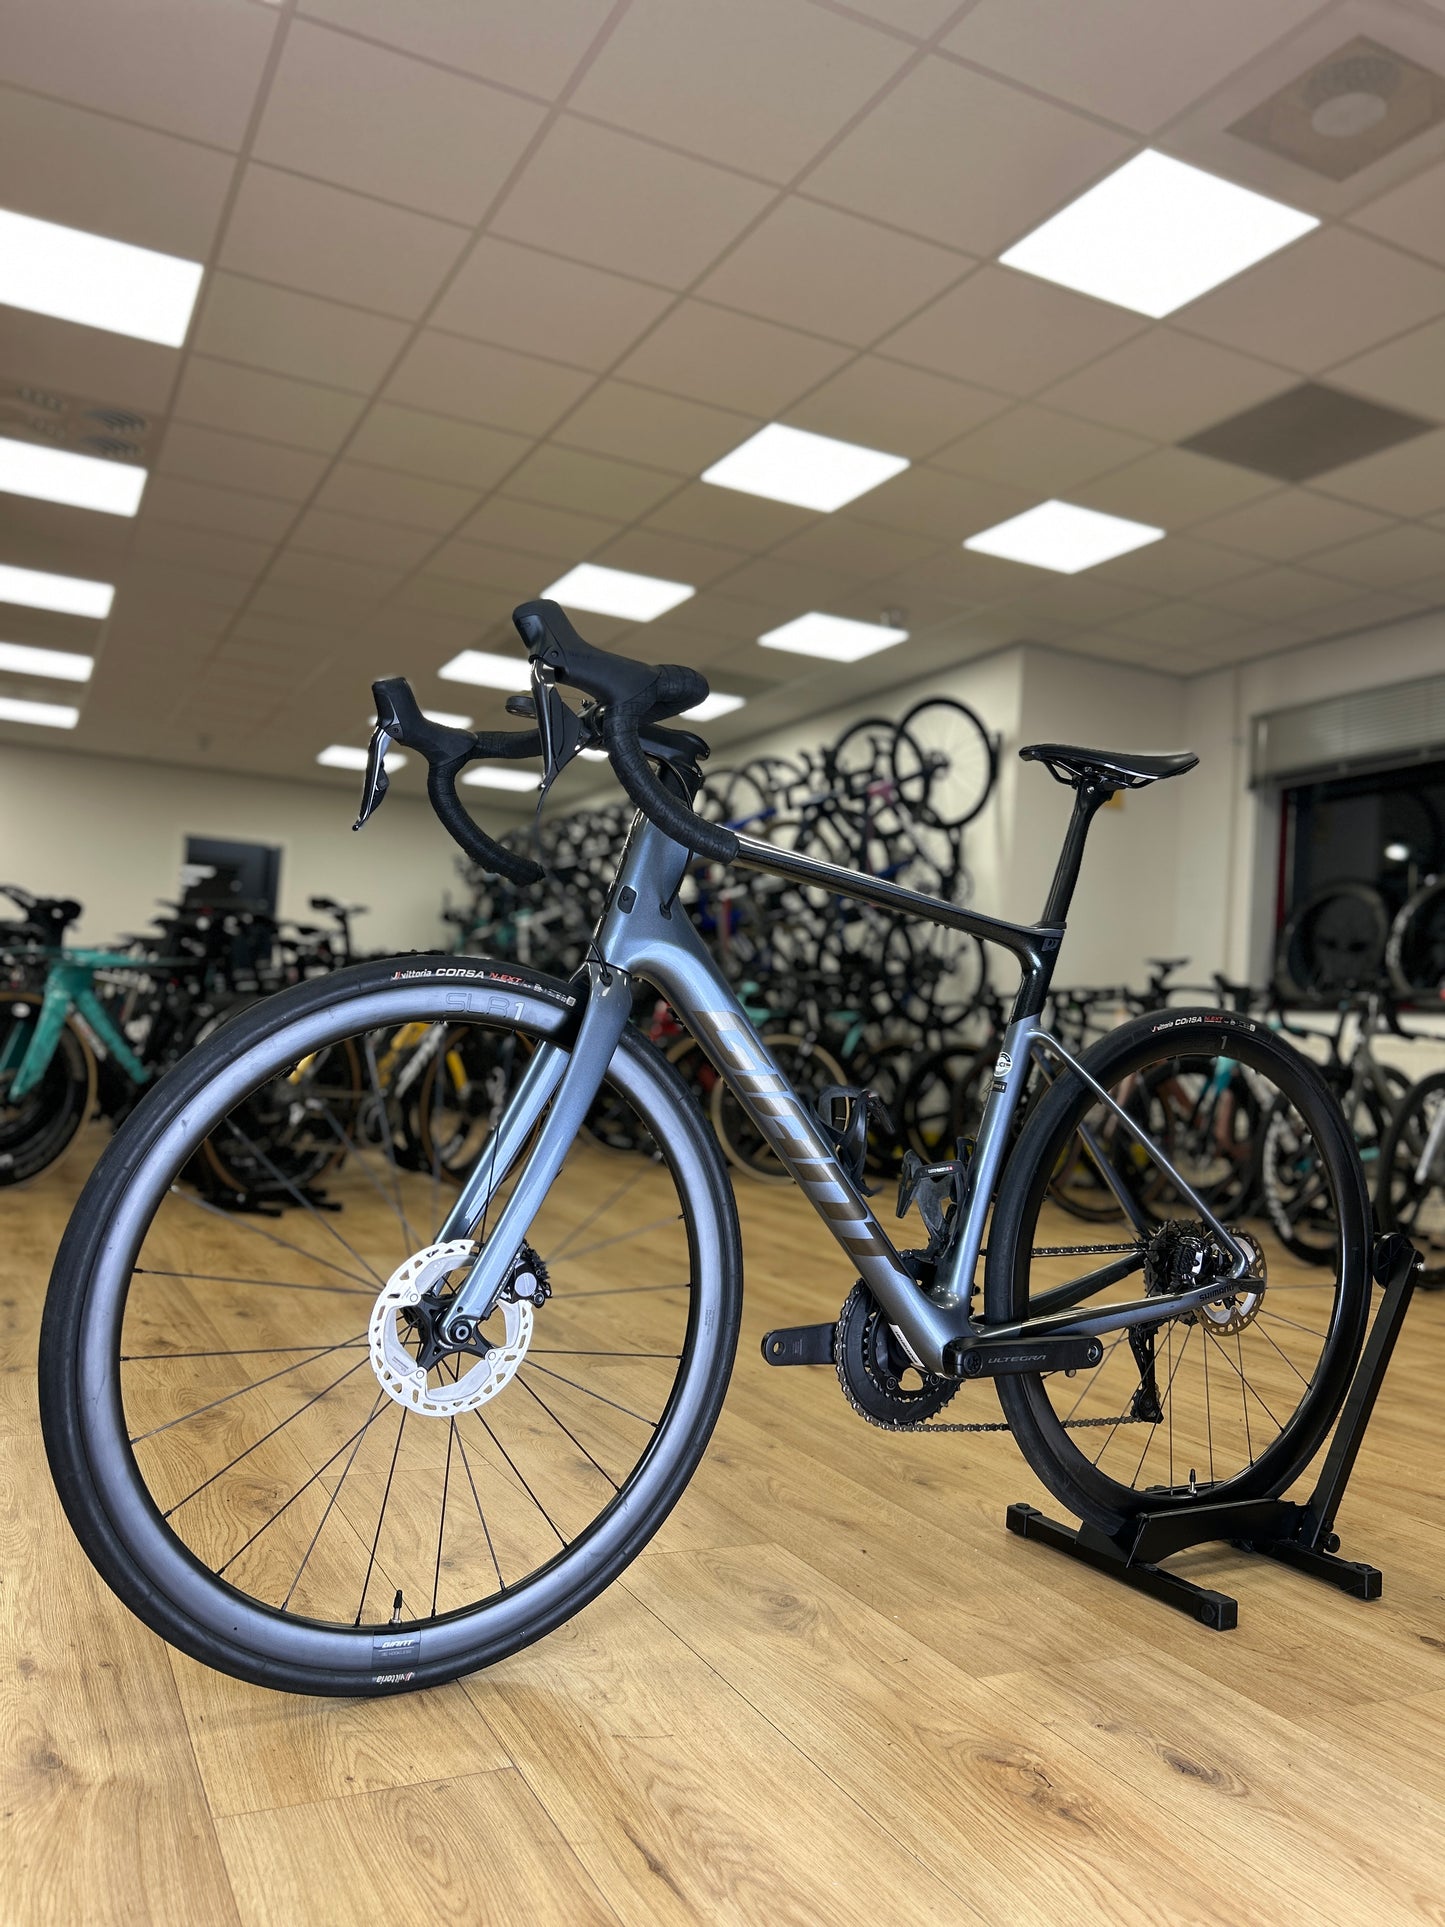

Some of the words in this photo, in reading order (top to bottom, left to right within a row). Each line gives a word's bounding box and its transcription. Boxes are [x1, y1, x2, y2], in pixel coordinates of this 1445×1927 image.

[400, 968, 432, 980] vittoria
[435, 968, 485, 979] CORSA
[489, 972, 523, 983] N.EXT
[513, 1001, 526, 1021] 1
[1175, 1017, 1202, 1026] CORSA
[691, 1010, 912, 1279] GIANT
[1199, 1285, 1235, 1302] SHIMANO
[988, 1354, 1047, 1364] ULTEGRA
[376, 1673, 405, 1684] vittoria
